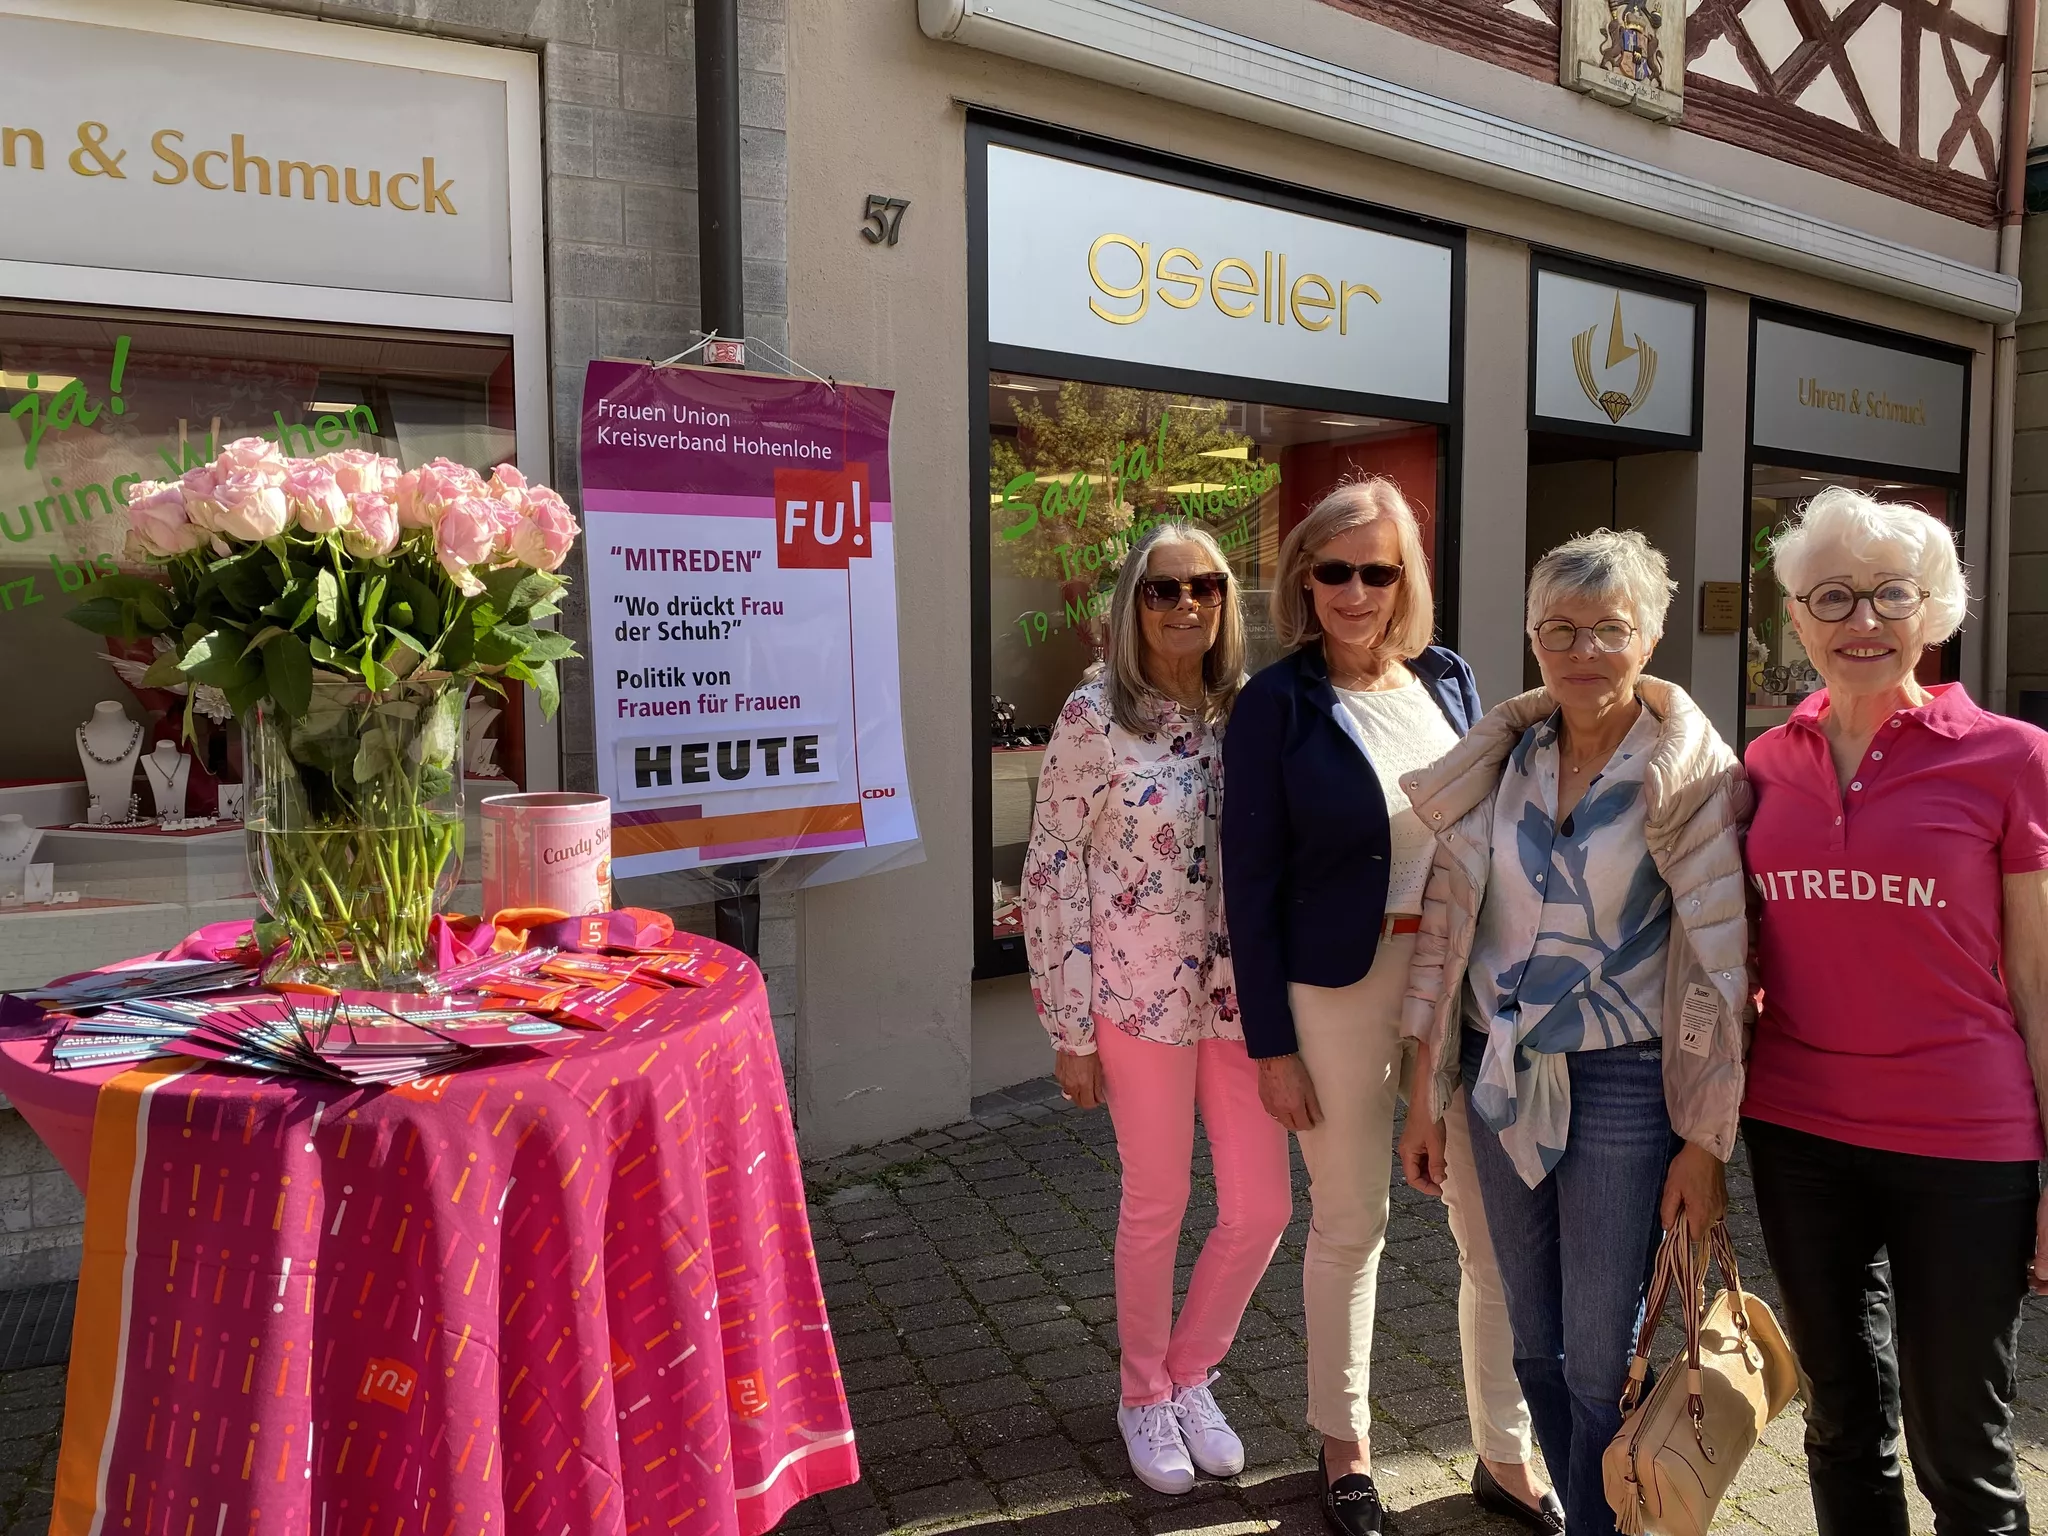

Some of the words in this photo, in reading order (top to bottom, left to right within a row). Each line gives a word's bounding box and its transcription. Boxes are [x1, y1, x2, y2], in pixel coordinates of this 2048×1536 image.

[69, 120, 127, 179] &
[151, 129, 458, 216] Schmuck
[860, 194, 911, 246] 57
[1088, 233, 1382, 335] gseller
[10, 335, 132, 471] ja!
[597, 398, 666, 423] Frauen
[673, 405, 731, 428] Union
[1798, 377, 1846, 415] Uhren
[1849, 388, 1861, 415] &
[1866, 391, 1927, 426] Schmuck
[597, 427, 727, 453] Kreisverband
[733, 436, 832, 460] Hohenlohe
[1002, 471, 1094, 542] Sag
[1110, 411, 1169, 511] ja!
[783, 480, 864, 547] FU!
[666, 595, 735, 617] drückt
[741, 597, 784, 616] Frau
[1064, 587, 1115, 629] Mär
[615, 621, 650, 642] der
[616, 667, 686, 690] Politik
[691, 669, 731, 686] von
[618, 699, 691, 718] Frauen
[697, 694, 728, 715] für
[734, 693, 801, 713] Frauen
[634, 734, 820, 789] HEUTE
[861, 787, 896, 799] CDU
[543, 837, 593, 865] Candy
[363, 1364, 412, 1397] FU!
